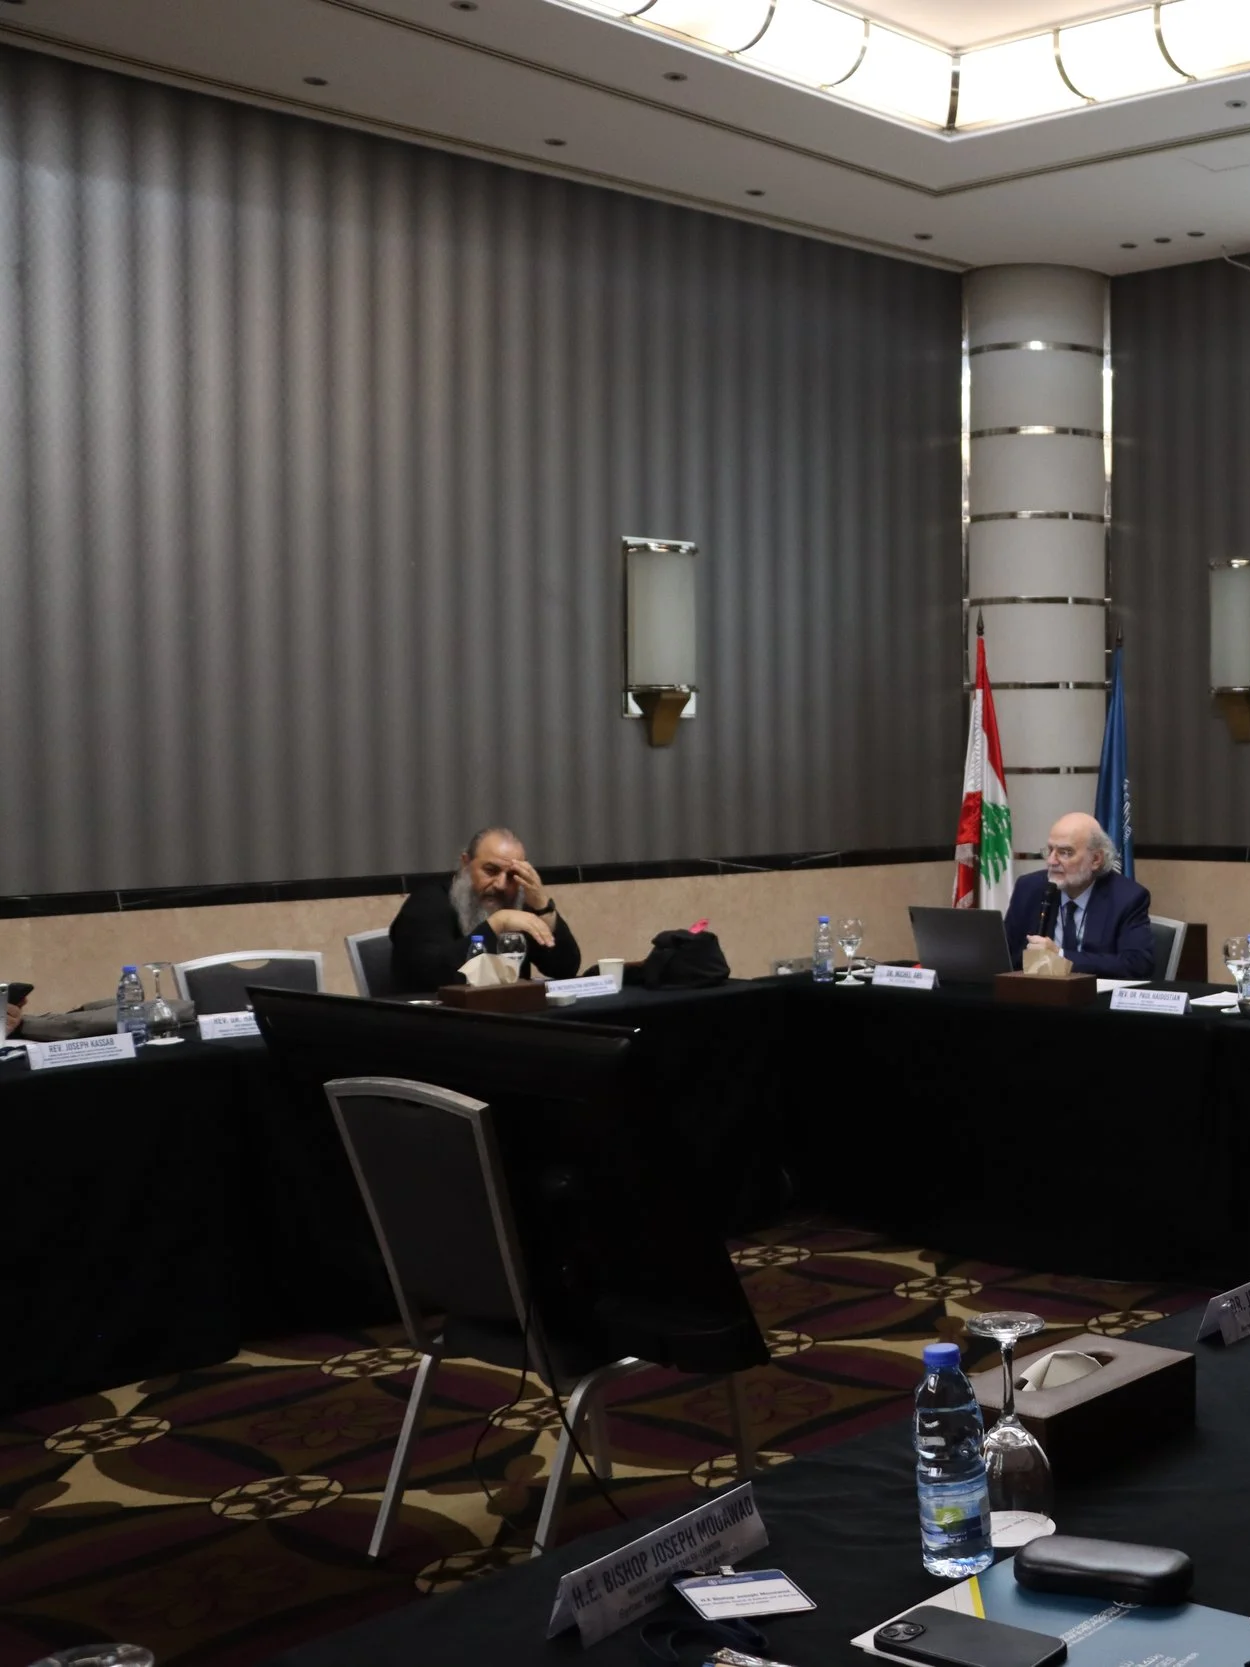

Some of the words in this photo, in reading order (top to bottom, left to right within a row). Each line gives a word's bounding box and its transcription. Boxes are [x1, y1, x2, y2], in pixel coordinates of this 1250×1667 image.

[65, 1040, 90, 1052] JOSEPH
[572, 1577, 603, 1611] H.E.
[603, 1552, 649, 1594] BISHOP
[649, 1529, 697, 1568] JOSEPH
[697, 1495, 755, 1541] MOUAWAD
